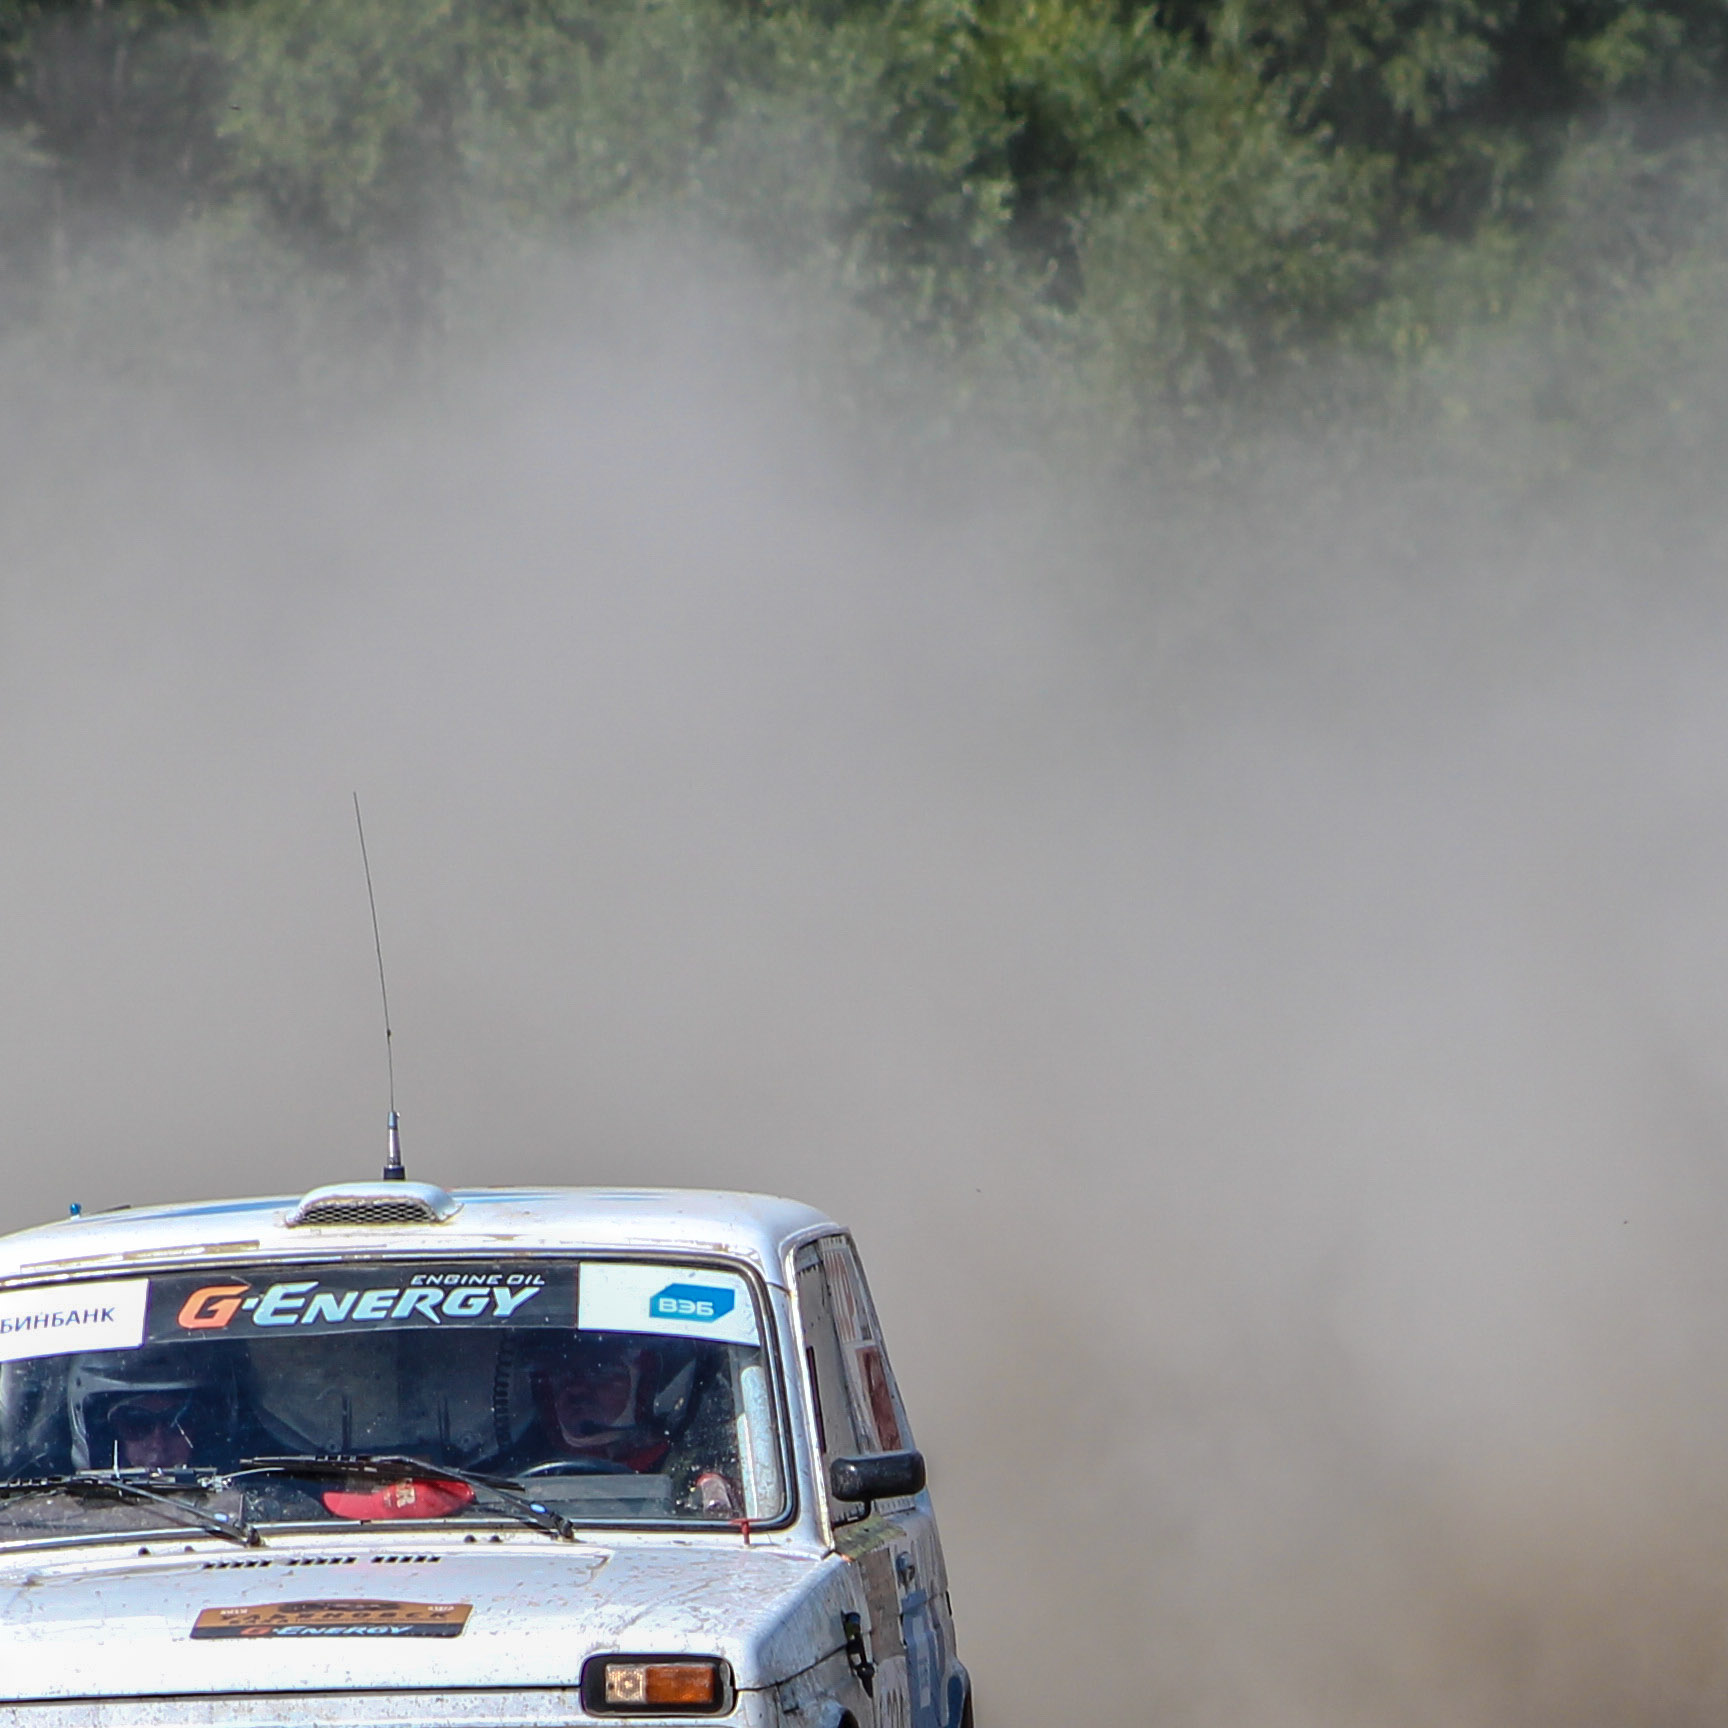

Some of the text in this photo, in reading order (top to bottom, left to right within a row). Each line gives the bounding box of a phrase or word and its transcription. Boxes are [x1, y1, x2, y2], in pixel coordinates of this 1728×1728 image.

[411, 1273, 546, 1286] ENGINE OIL
[658, 1298, 715, 1317] ВЭБ
